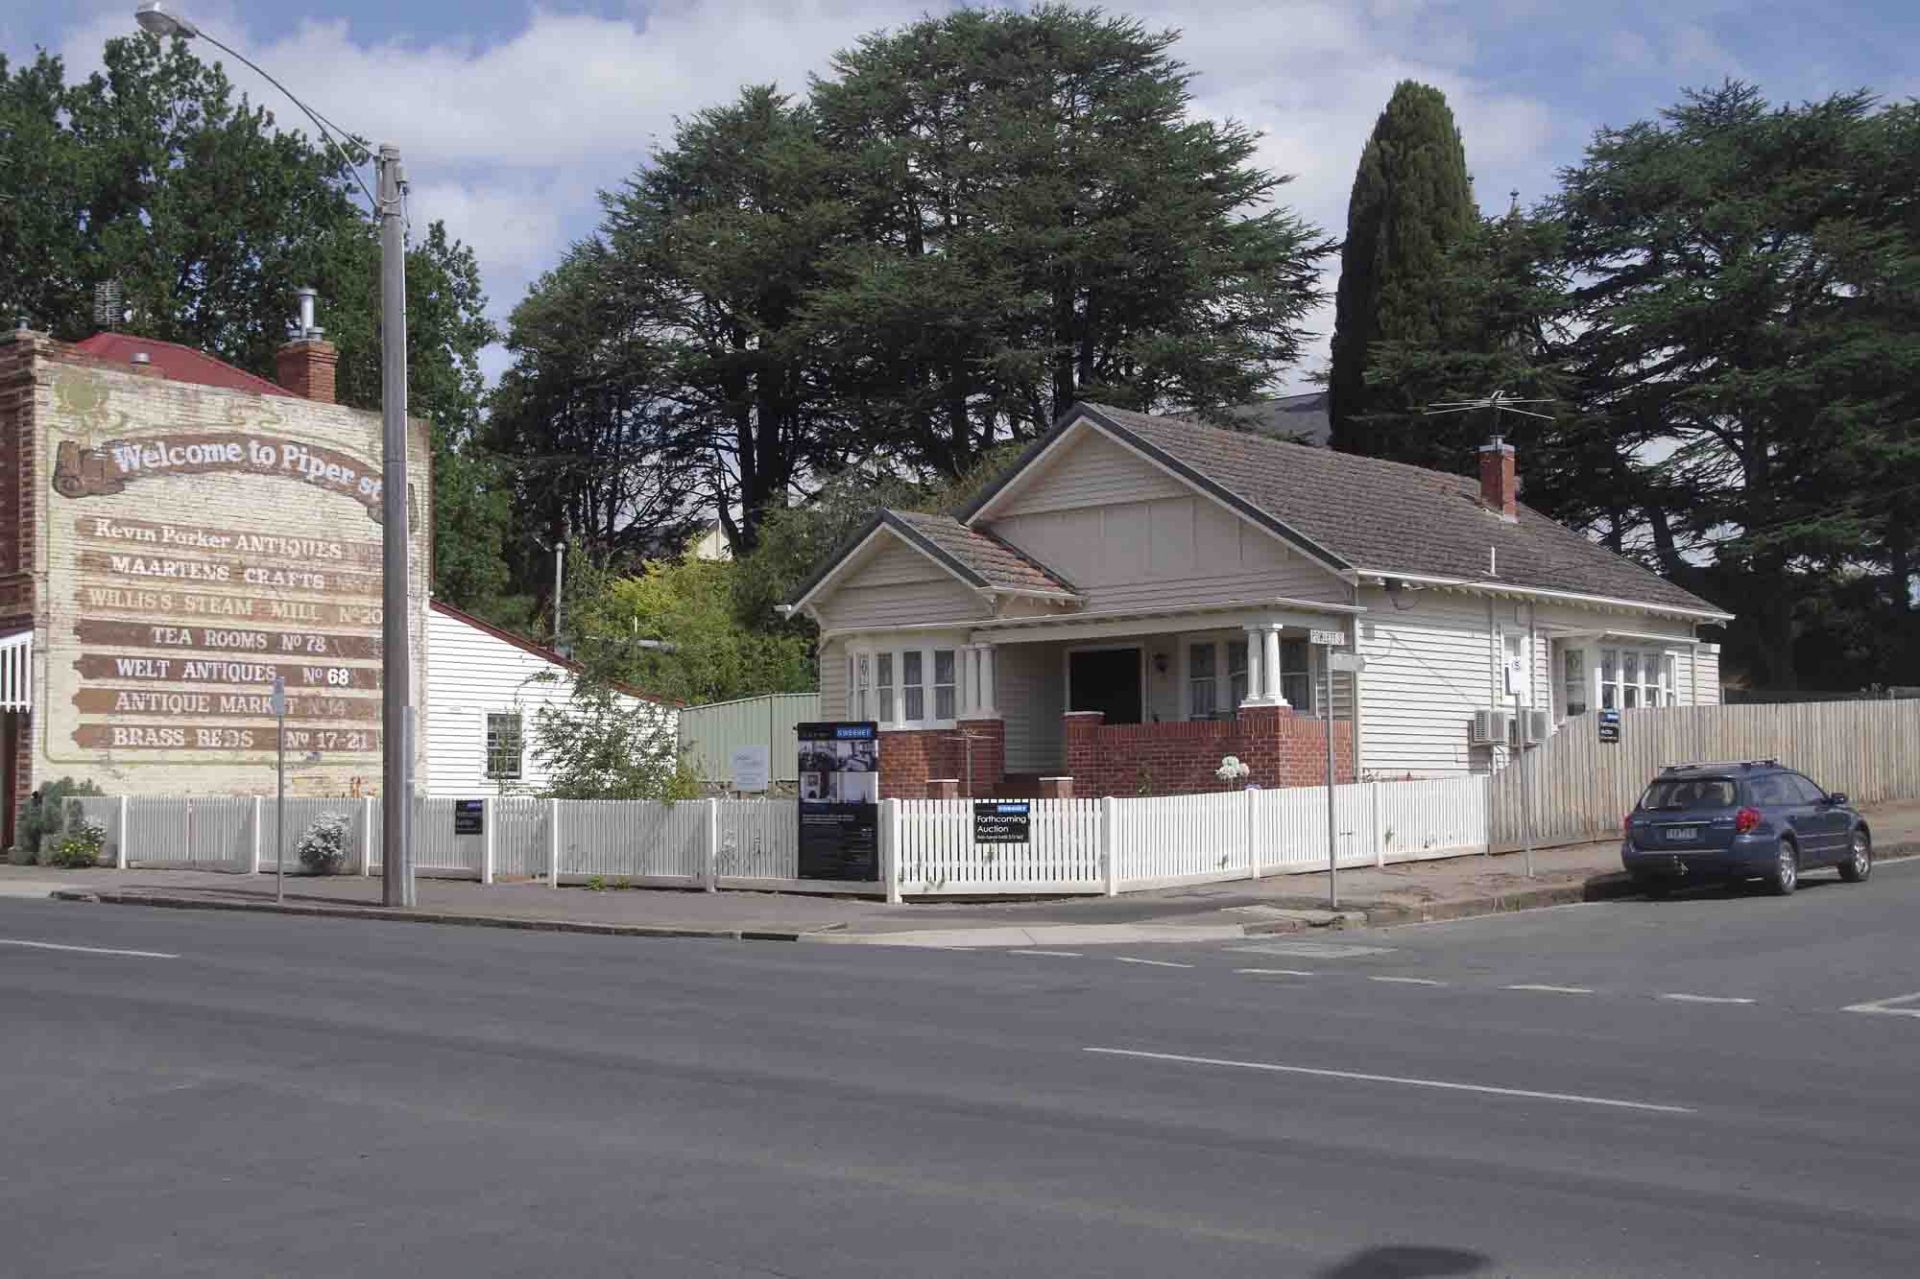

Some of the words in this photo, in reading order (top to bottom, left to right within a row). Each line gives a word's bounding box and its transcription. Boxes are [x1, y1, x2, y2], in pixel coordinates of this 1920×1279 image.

[114, 440, 243, 473] Welcome
[248, 440, 276, 466] to
[281, 443, 355, 484] Piper
[94, 518, 156, 542] Kevin
[161, 525, 231, 548] Parker
[234, 533, 342, 559] ANTIQUES
[243, 567, 325, 590] CRAFTS
[184, 594, 253, 616] STEAM
[270, 600, 322, 620] MILL
[151, 626, 193, 645] TEA
[204, 629, 268, 650] ROOMS
[305, 635, 327, 652] 78
[116, 658, 170, 678] WELT
[182, 661, 277, 682] ANTIQUES
[327, 668, 349, 685] 68
[114, 691, 211, 714] ANTIQUE
[220, 695, 299, 714] MARKT
[112, 727, 185, 746] BRASS
[195, 728, 254, 748] BEDS
[317, 731, 368, 749] 17-21
[977, 815, 1027, 825] Forthcoming
[977, 825, 1009, 833] Auction
